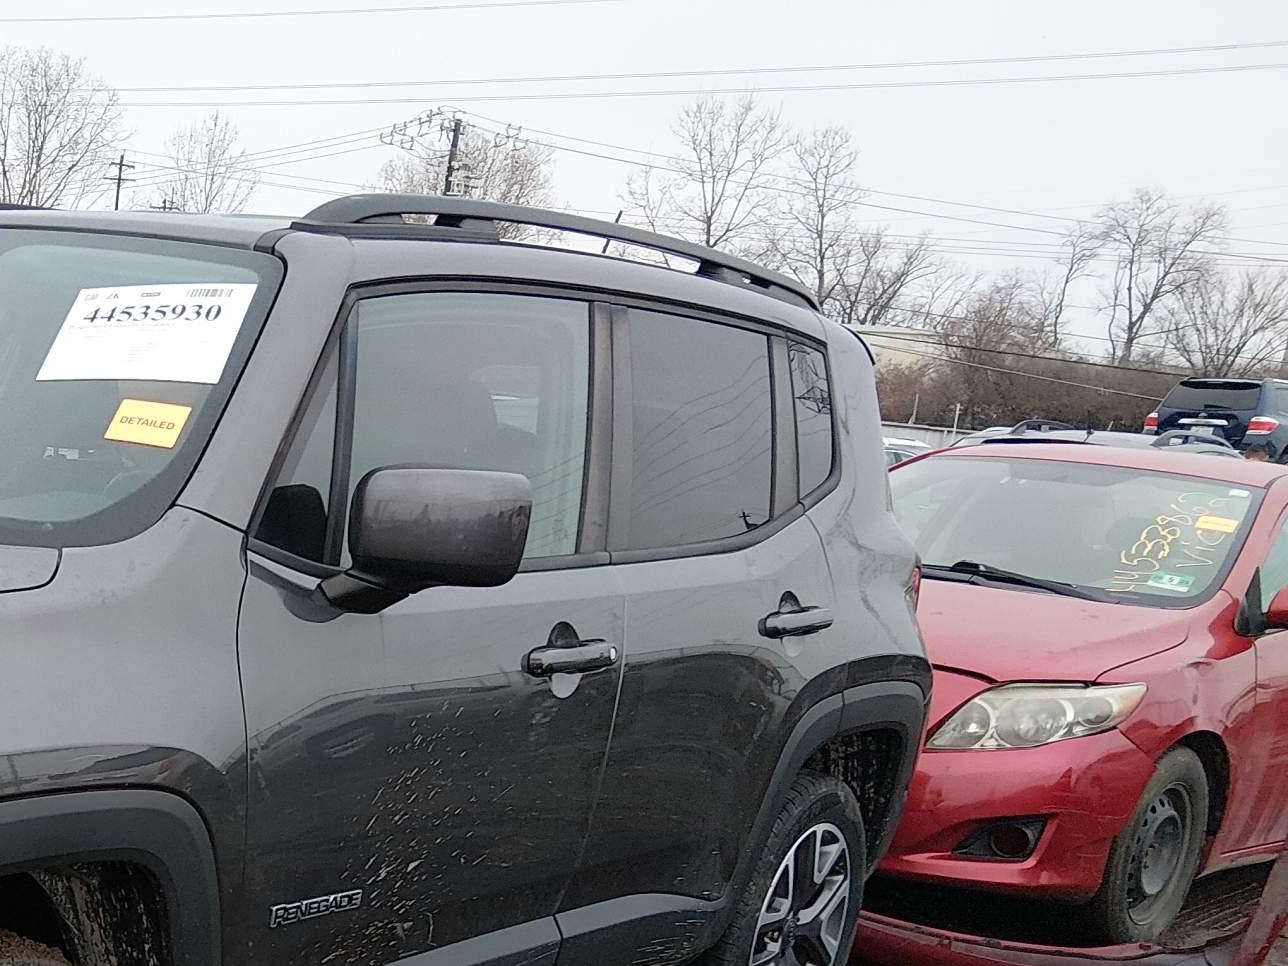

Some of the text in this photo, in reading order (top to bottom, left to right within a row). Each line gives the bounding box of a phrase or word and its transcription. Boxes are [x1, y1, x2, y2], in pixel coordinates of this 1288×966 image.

[83, 304, 222, 323] 44535930
[119, 415, 176, 430] DETAILED
[270, 889, 362, 928] RENEGADE
